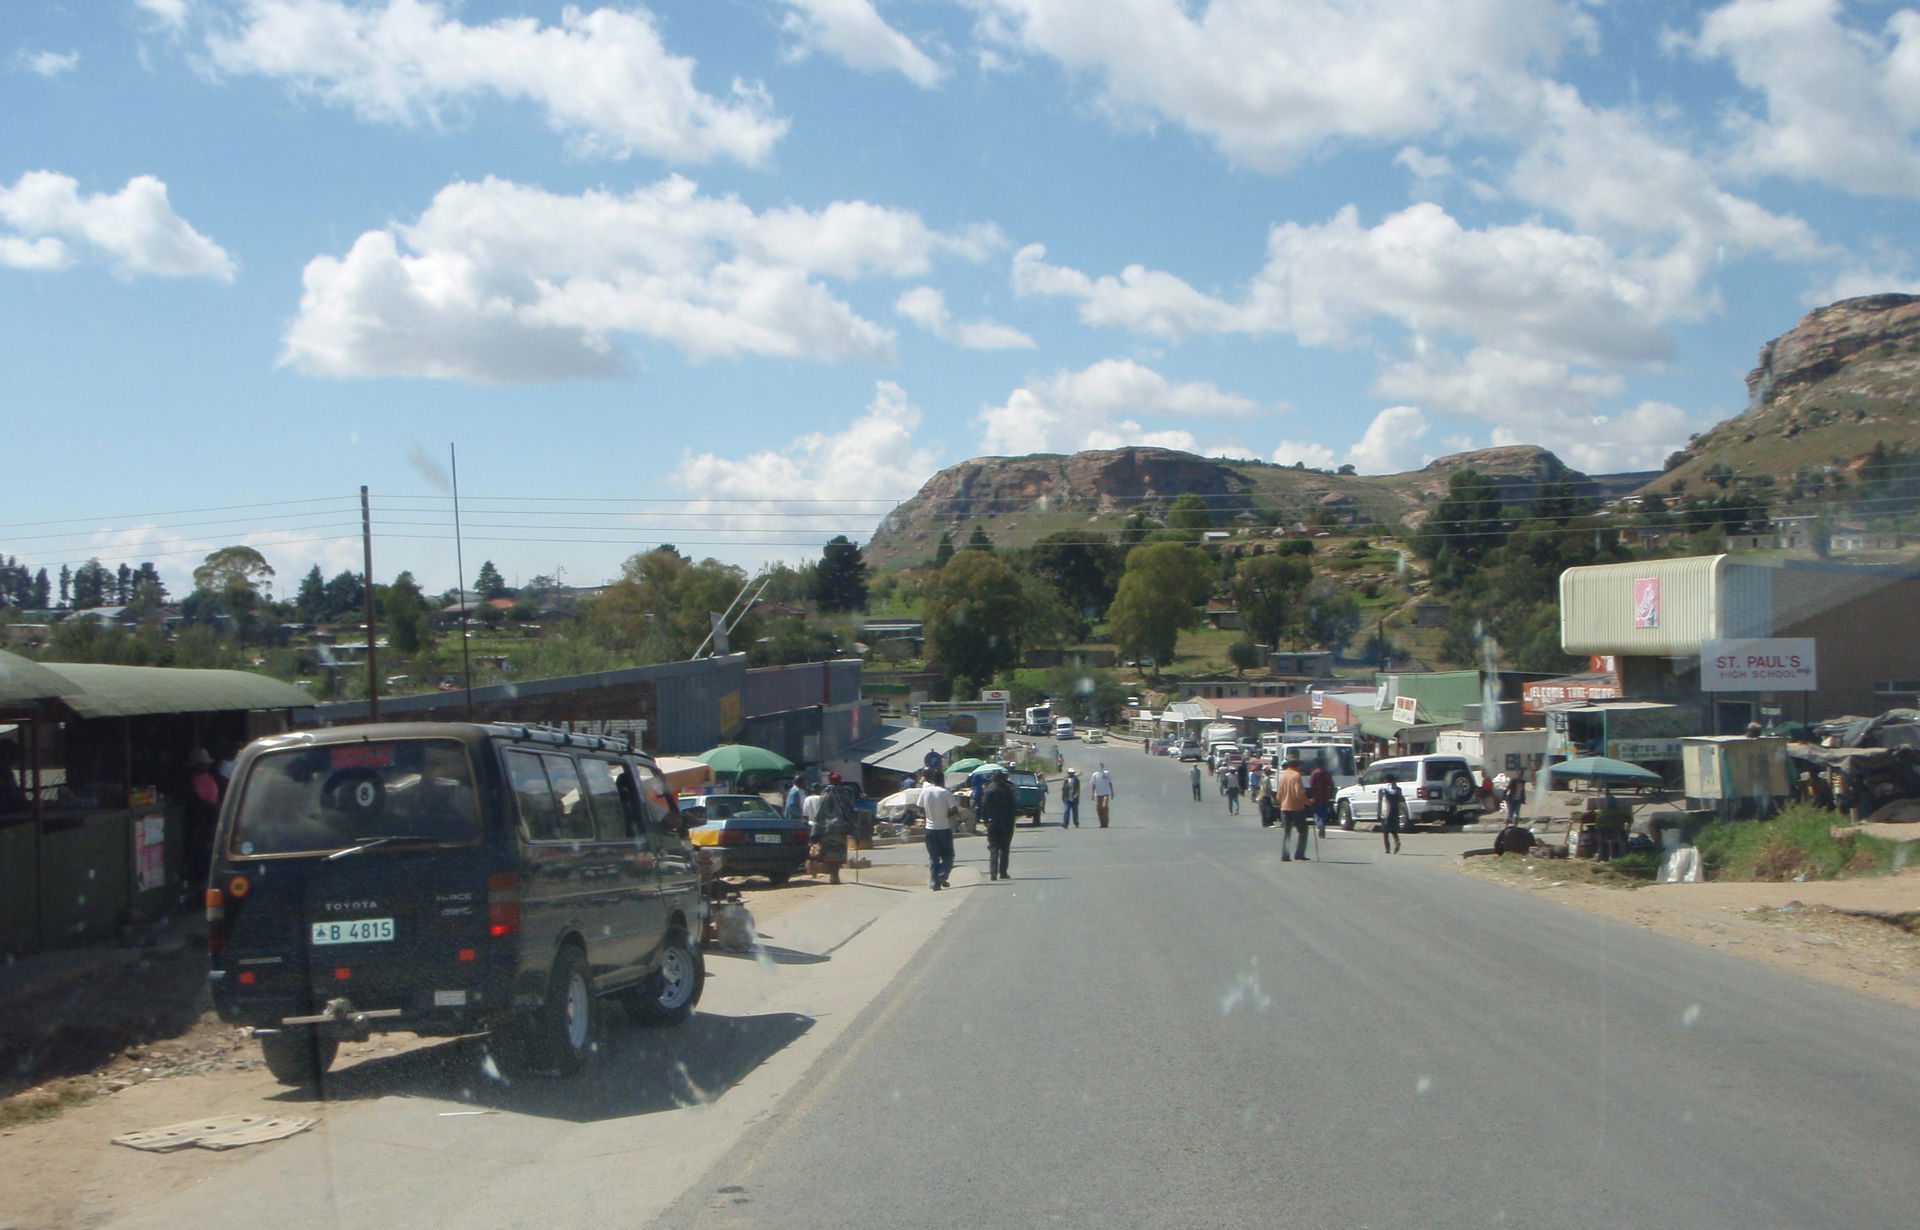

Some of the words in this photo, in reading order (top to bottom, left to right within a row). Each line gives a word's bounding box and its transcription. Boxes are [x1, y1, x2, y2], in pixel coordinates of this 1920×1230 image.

[1716, 655, 1740, 669] ST.
[1747, 655, 1801, 669] PAUL'S
[1720, 670, 1747, 679] HIGH
[1752, 670, 1797, 679] SCHOOL
[325, 901, 378, 911] TOYOTA
[330, 925, 341, 941] B
[349, 921, 391, 939] 4815
